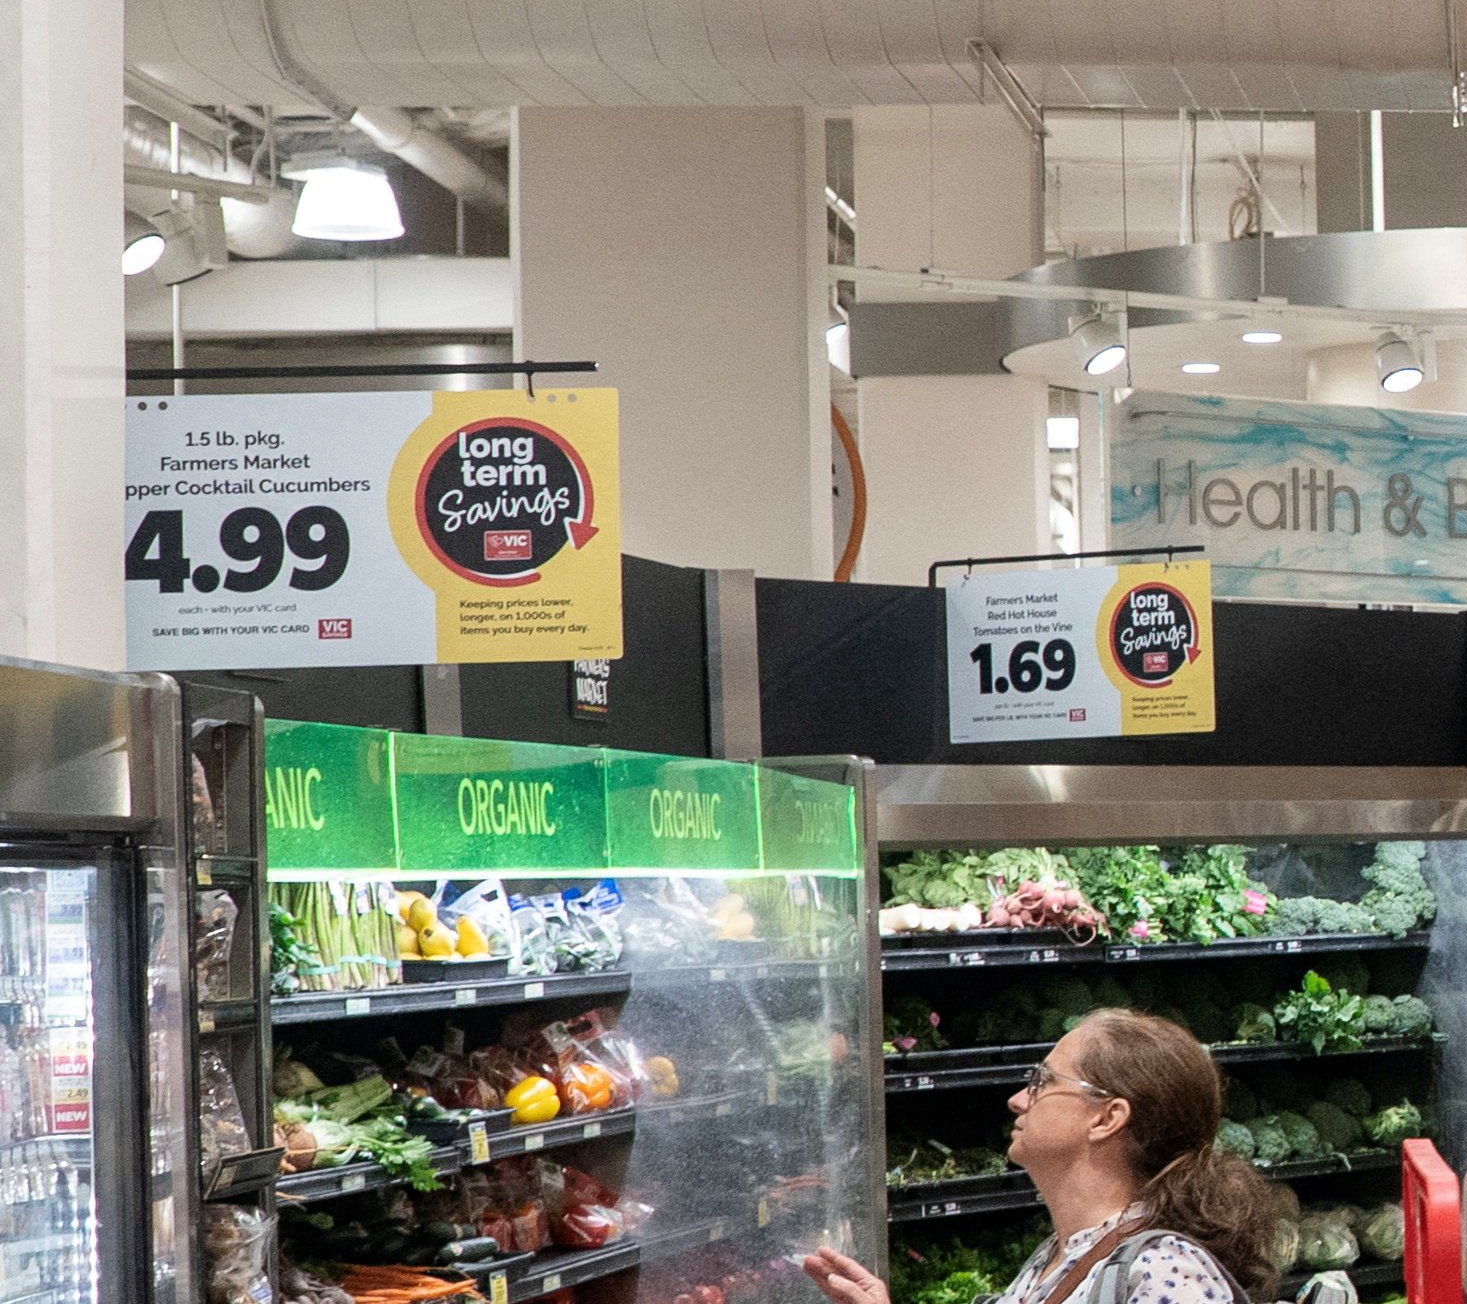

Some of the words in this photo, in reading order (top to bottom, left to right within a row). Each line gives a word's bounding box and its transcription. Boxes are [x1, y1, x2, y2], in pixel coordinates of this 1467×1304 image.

[185, 432, 210, 447] 1.5
[217, 432, 239, 446] lb.
[245, 431, 284, 449] pkg.
[458, 432, 533, 464] long
[161, 456, 238, 471] Farmers
[244, 455, 311, 469] Market
[461, 460, 547, 486] term
[175, 479, 254, 495] Cocktail
[259, 478, 370, 494] Cucumbers
[1156, 457, 1361, 534] Health
[1384, 473, 1427, 539] &
[438, 487, 570, 532] Savings
[504, 535, 527, 546] VIC
[125, 506, 350, 593] 4.99
[460, 600, 504, 610] Keeping
[506, 600, 539, 609] prices
[542, 599, 573, 607] lower,
[986, 596, 1023, 607] Farmers
[1026, 594, 1058, 605] Market
[1130, 592, 1168, 611] long
[460, 613, 497, 623] longer,
[555, 611, 565, 619] of
[988, 611, 1006, 621] Red
[1009, 611, 1025, 620] Hot
[1028, 609, 1057, 618] House
[1132, 609, 1175, 626] term
[153, 628, 179, 636] SAVE
[182, 628, 199, 636] BIG
[203, 627, 228, 635] WITH
[231, 626, 259, 634] YOUR
[281, 625, 310, 633] CARD
[323, 621, 348, 632] VIC
[461, 627, 489, 635] items
[492, 627, 511, 636] you
[514, 626, 533, 634] buy
[537, 625, 565, 635] every
[568, 624, 588, 633] day.
[973, 626, 1015, 637] Tomatoes
[1018, 626, 1033, 635] on
[1036, 624, 1049, 634] the
[1052, 623, 1073, 633] Vine
[1121, 624, 1187, 655] Savings
[970, 639, 1076, 694] 1.69
[458, 779, 556, 836] ORGANIC
[650, 788, 721, 841] ORGANIC
[55, 1063, 86, 1075] NEW
[55, 1110, 87, 1123] NEW
